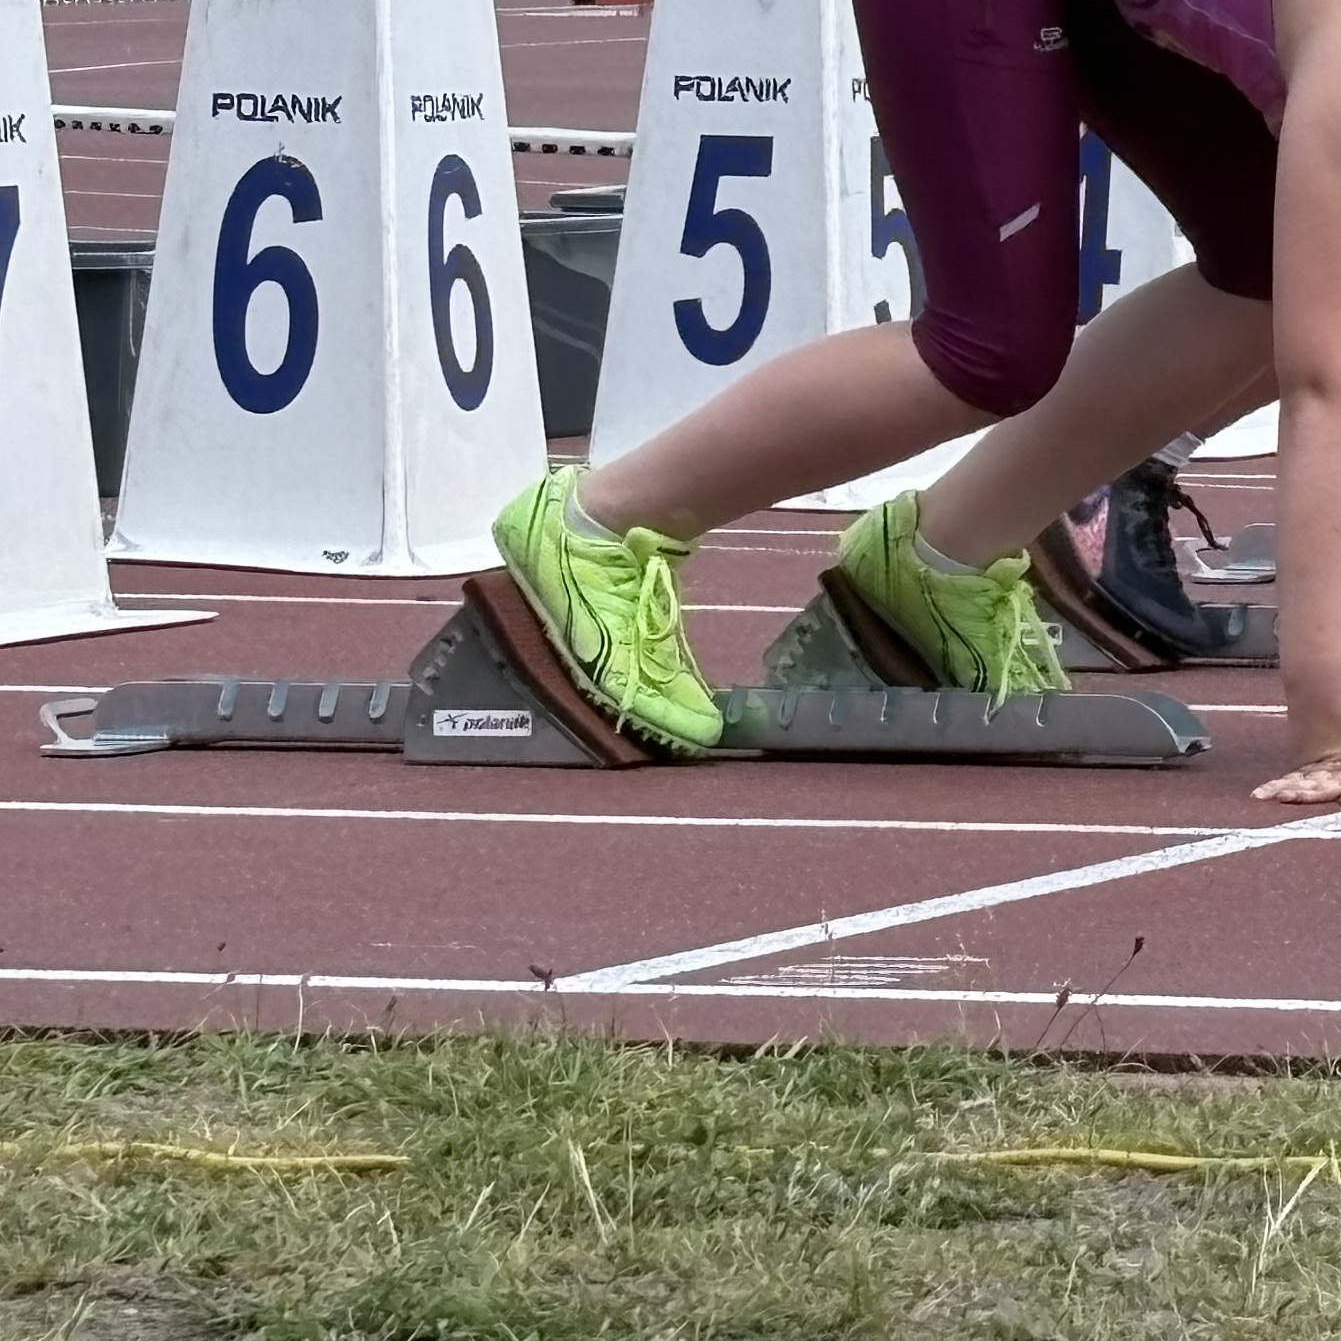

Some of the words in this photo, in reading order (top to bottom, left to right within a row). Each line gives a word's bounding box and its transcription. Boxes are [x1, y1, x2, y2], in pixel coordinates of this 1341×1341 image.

[211, 92, 344, 124] POLANIK
[410, 93, 485, 123] POLANIK
[672, 75, 792, 104] POLANIK
[212, 155, 323, 415] 6
[428, 154, 494, 412] 6
[673, 134, 774, 367] 5
